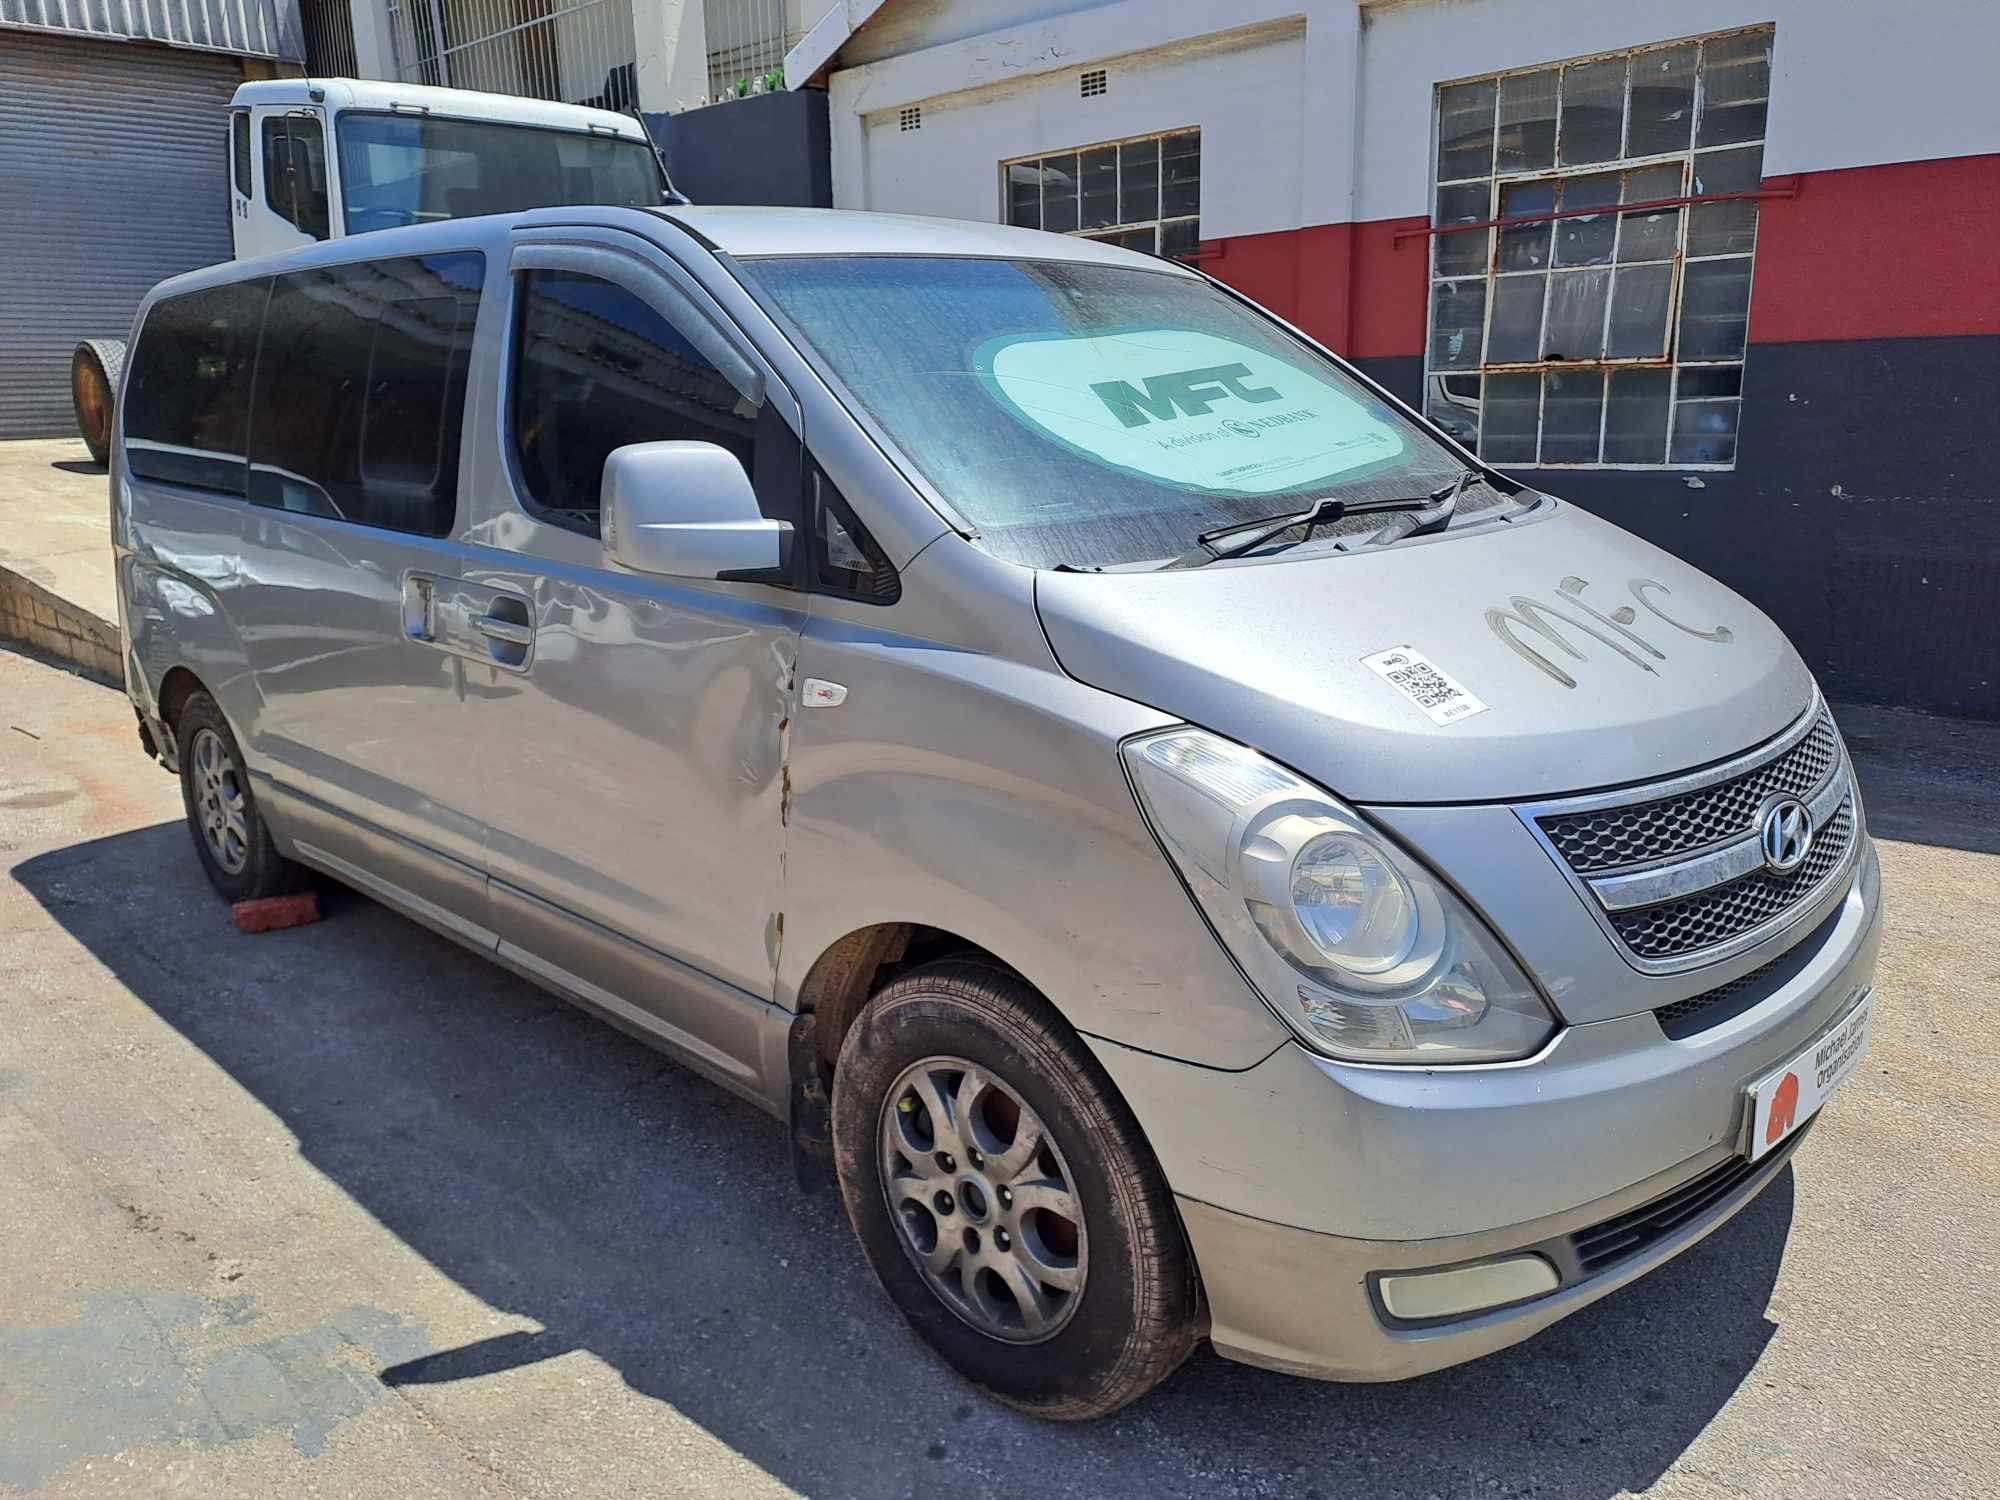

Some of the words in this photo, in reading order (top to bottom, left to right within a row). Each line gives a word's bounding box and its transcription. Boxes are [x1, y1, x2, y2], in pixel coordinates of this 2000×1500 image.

[1089, 362, 1284, 429] MFC
[1251, 407, 1322, 431] NEDBANK
[1484, 575, 1735, 690] MFC
[1814, 1026, 1848, 1071] Michael
[1816, 1031, 1864, 1089] Organisation
